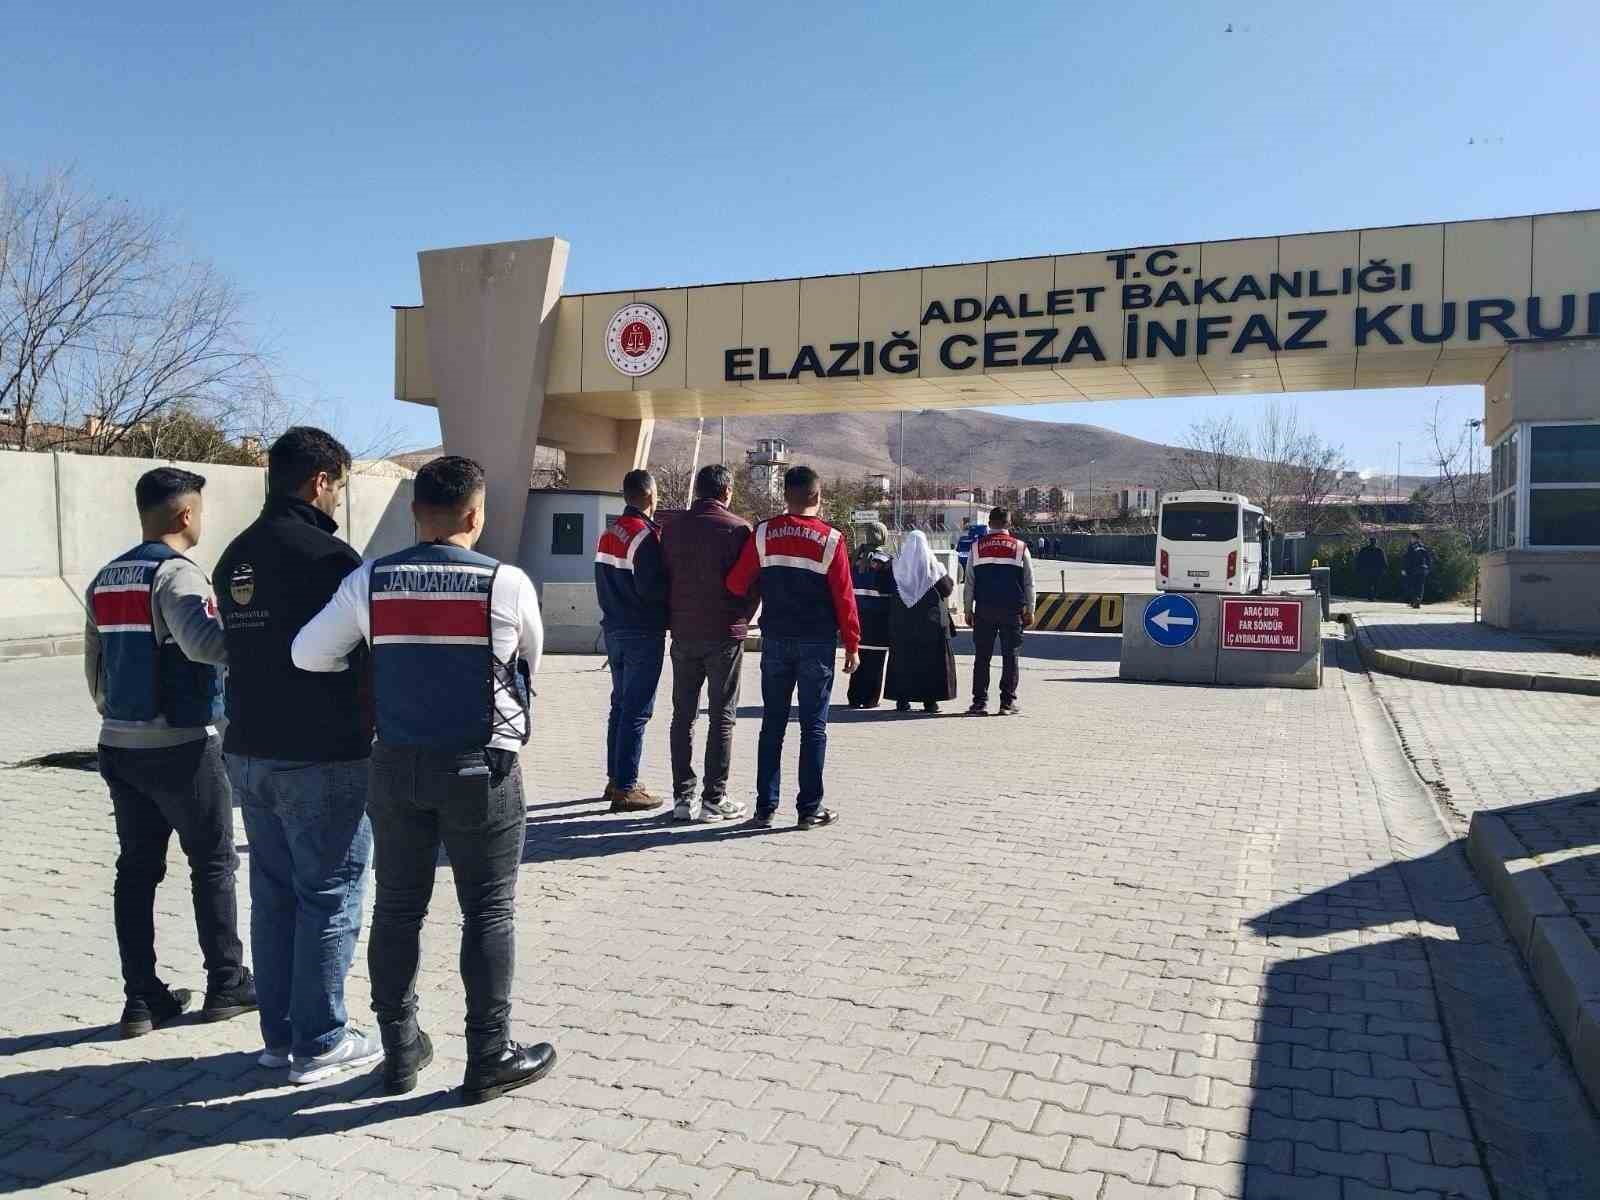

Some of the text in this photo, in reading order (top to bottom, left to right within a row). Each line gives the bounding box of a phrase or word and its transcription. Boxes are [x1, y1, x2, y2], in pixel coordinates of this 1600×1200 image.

[1107, 250, 1191, 279] T.C.
[920, 259, 1412, 325] ADALET BAKANLIĞI
[725, 331, 918, 381] ELAZIĞ
[940, 326, 1106, 370] CEZA
[1127, 309, 1328, 359] İNFAZ
[767, 525, 826, 546] JANDARMA
[384, 572, 478, 592] JANDARMA
[1243, 606, 1279, 618] ARAÇ DUR
[1239, 620, 1252, 630] FAR
[1281, 635, 1295, 645] YAK
